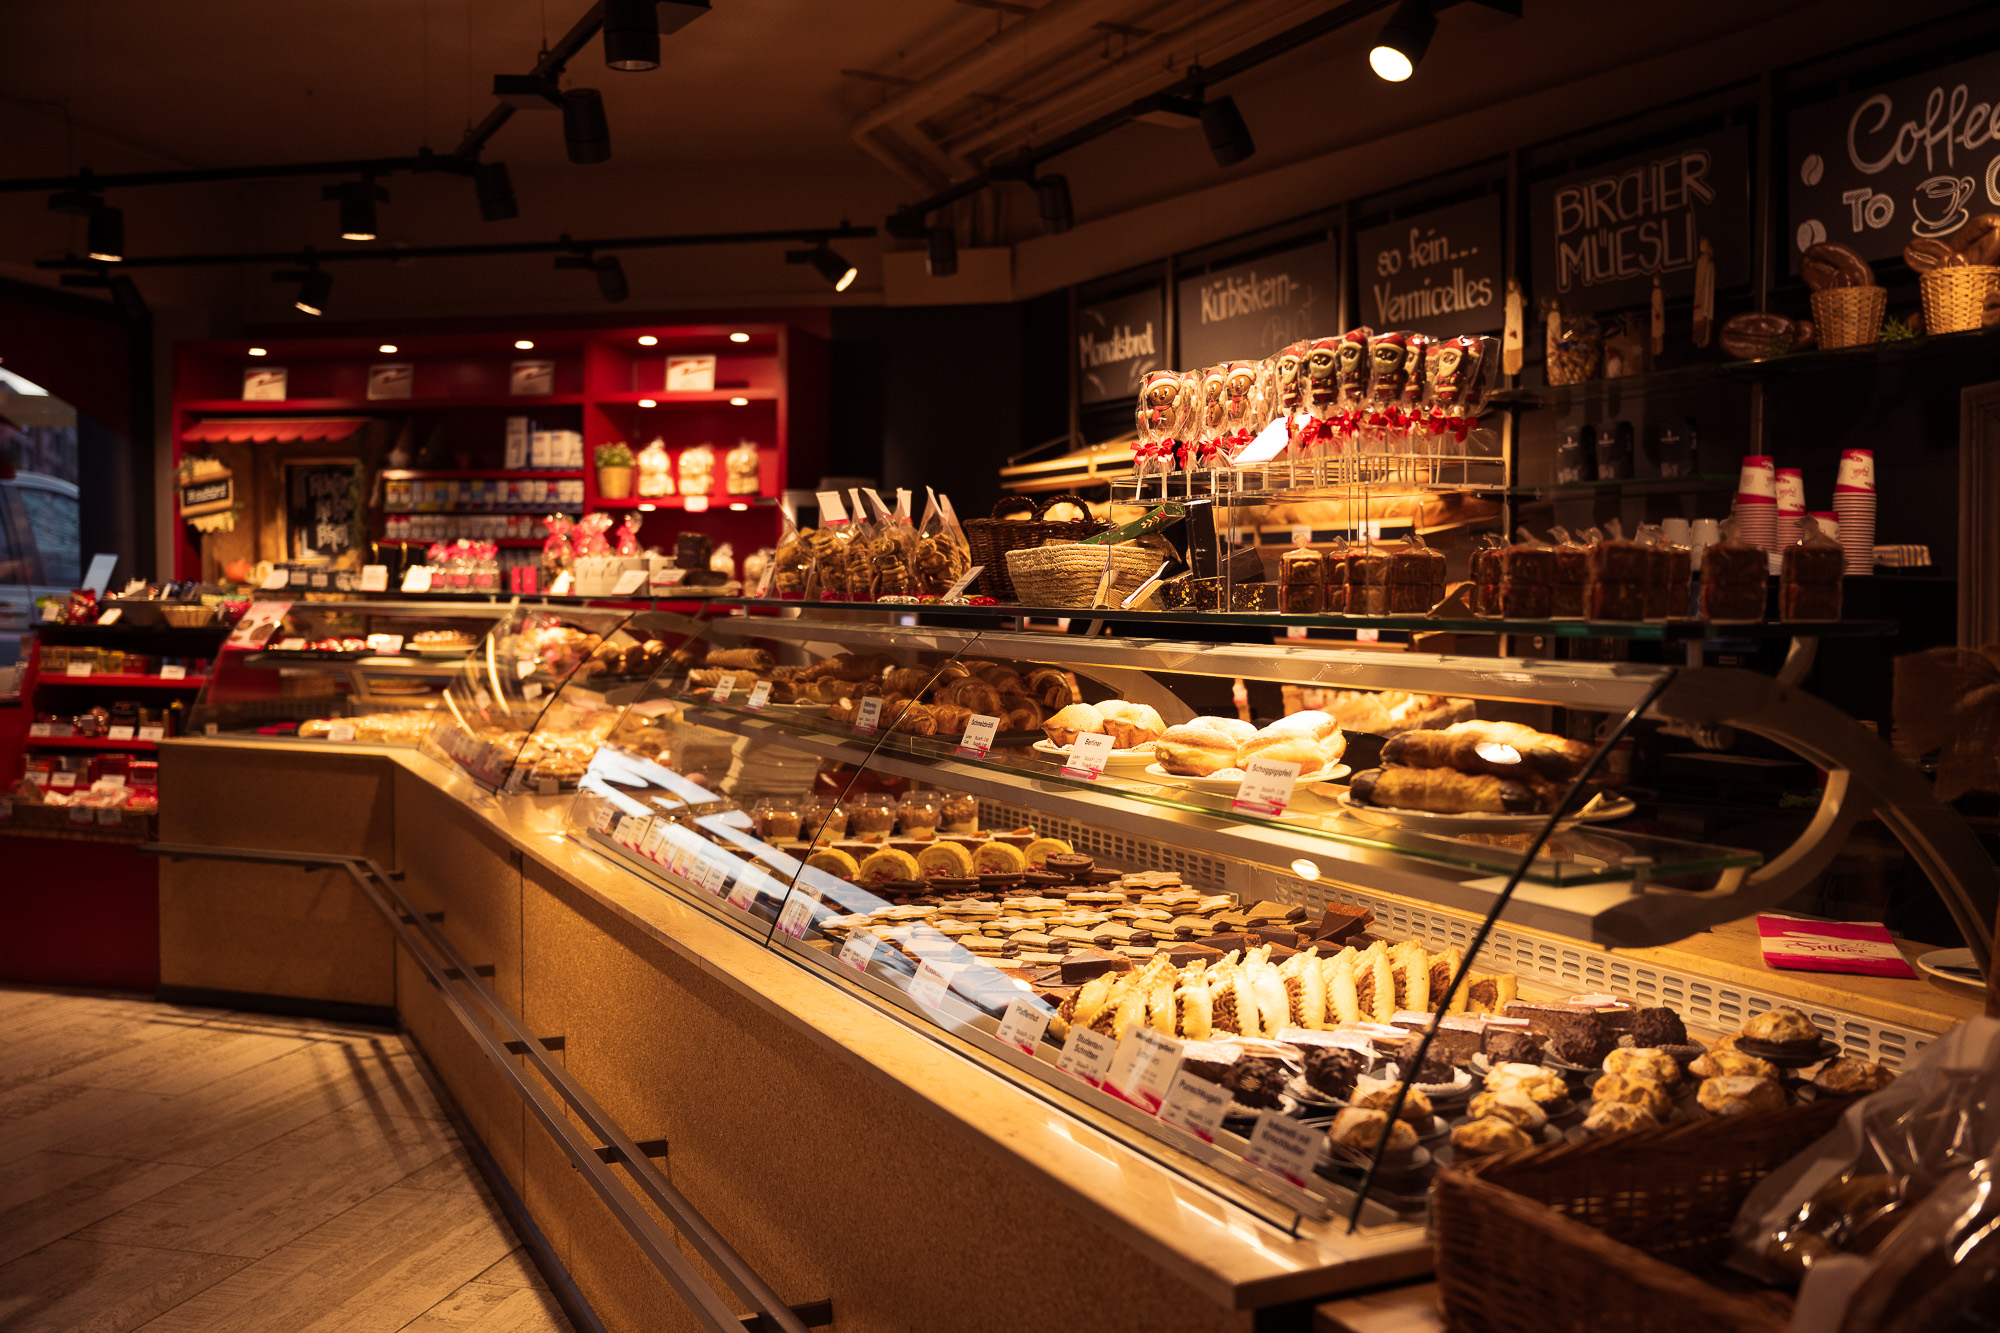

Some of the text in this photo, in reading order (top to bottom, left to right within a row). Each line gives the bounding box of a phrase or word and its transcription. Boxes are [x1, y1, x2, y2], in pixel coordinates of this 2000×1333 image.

[1554, 150, 1717, 238] BIRCHER
[1378, 247, 1402, 276] so
[1556, 208, 1697, 294] MÜESLI
[1200, 272, 1301, 325] Kürbiskern-
[1373, 267, 1494, 326] Vermicelles
[1084, 738, 1102, 747] Berliner
